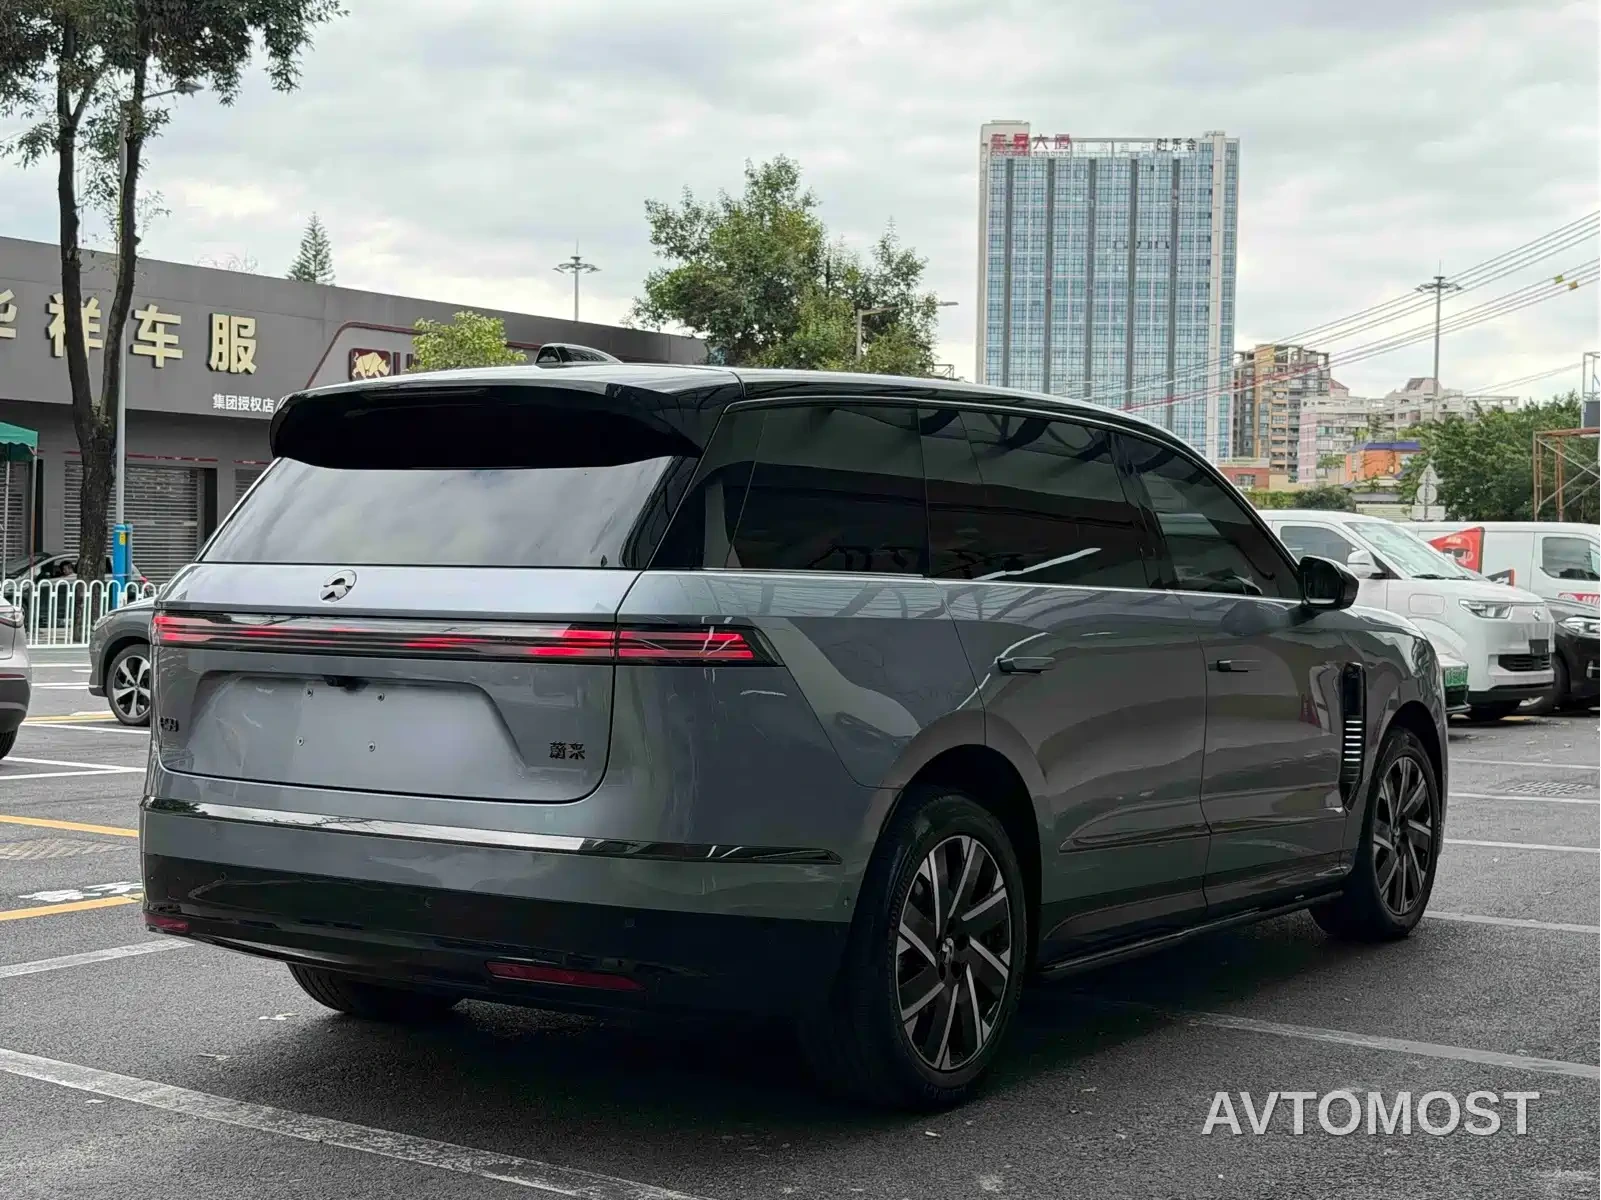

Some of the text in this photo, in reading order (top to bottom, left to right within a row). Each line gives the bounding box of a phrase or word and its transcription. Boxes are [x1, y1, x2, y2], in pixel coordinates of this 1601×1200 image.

[212, 393, 275, 414] 集团授权店
